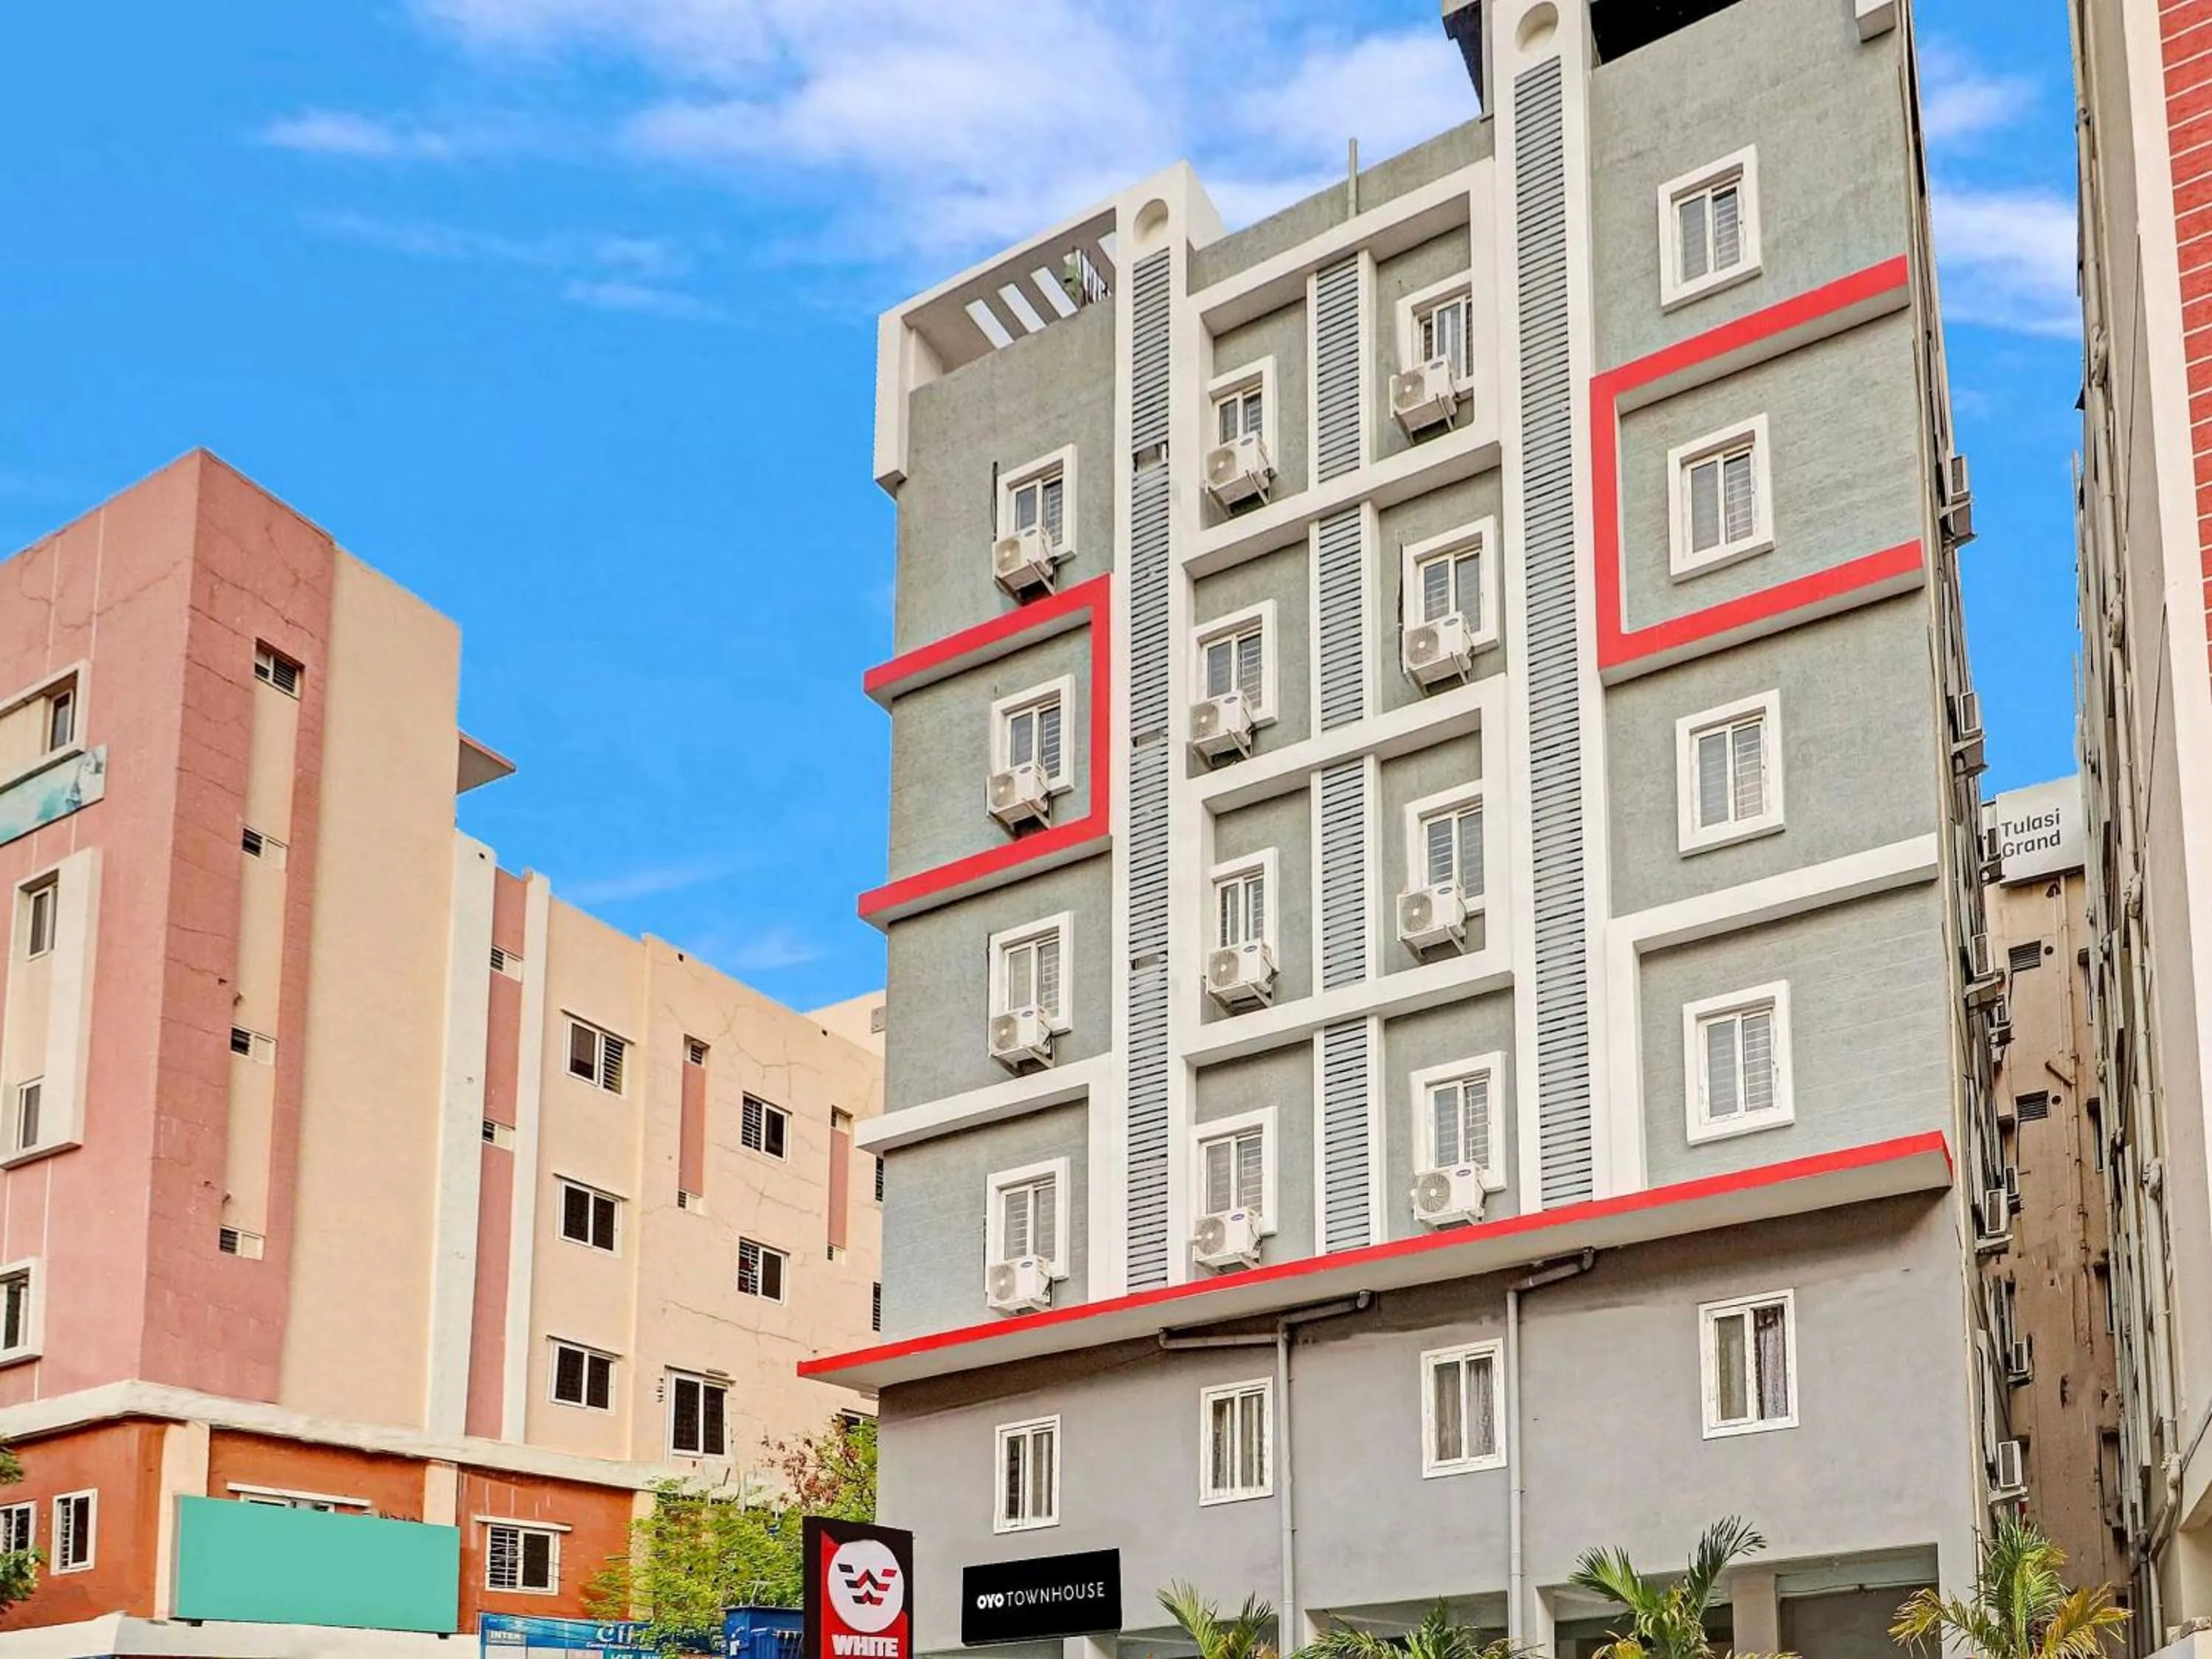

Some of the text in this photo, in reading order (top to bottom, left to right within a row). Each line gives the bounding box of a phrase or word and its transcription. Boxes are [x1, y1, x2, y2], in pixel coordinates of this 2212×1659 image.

[2000, 807, 2060, 838] Tulasi
[2002, 830, 2061, 858] Grand
[977, 1582, 1105, 1610] OYO TOWNHOUSE
[831, 1634, 899, 1658] WHITE
